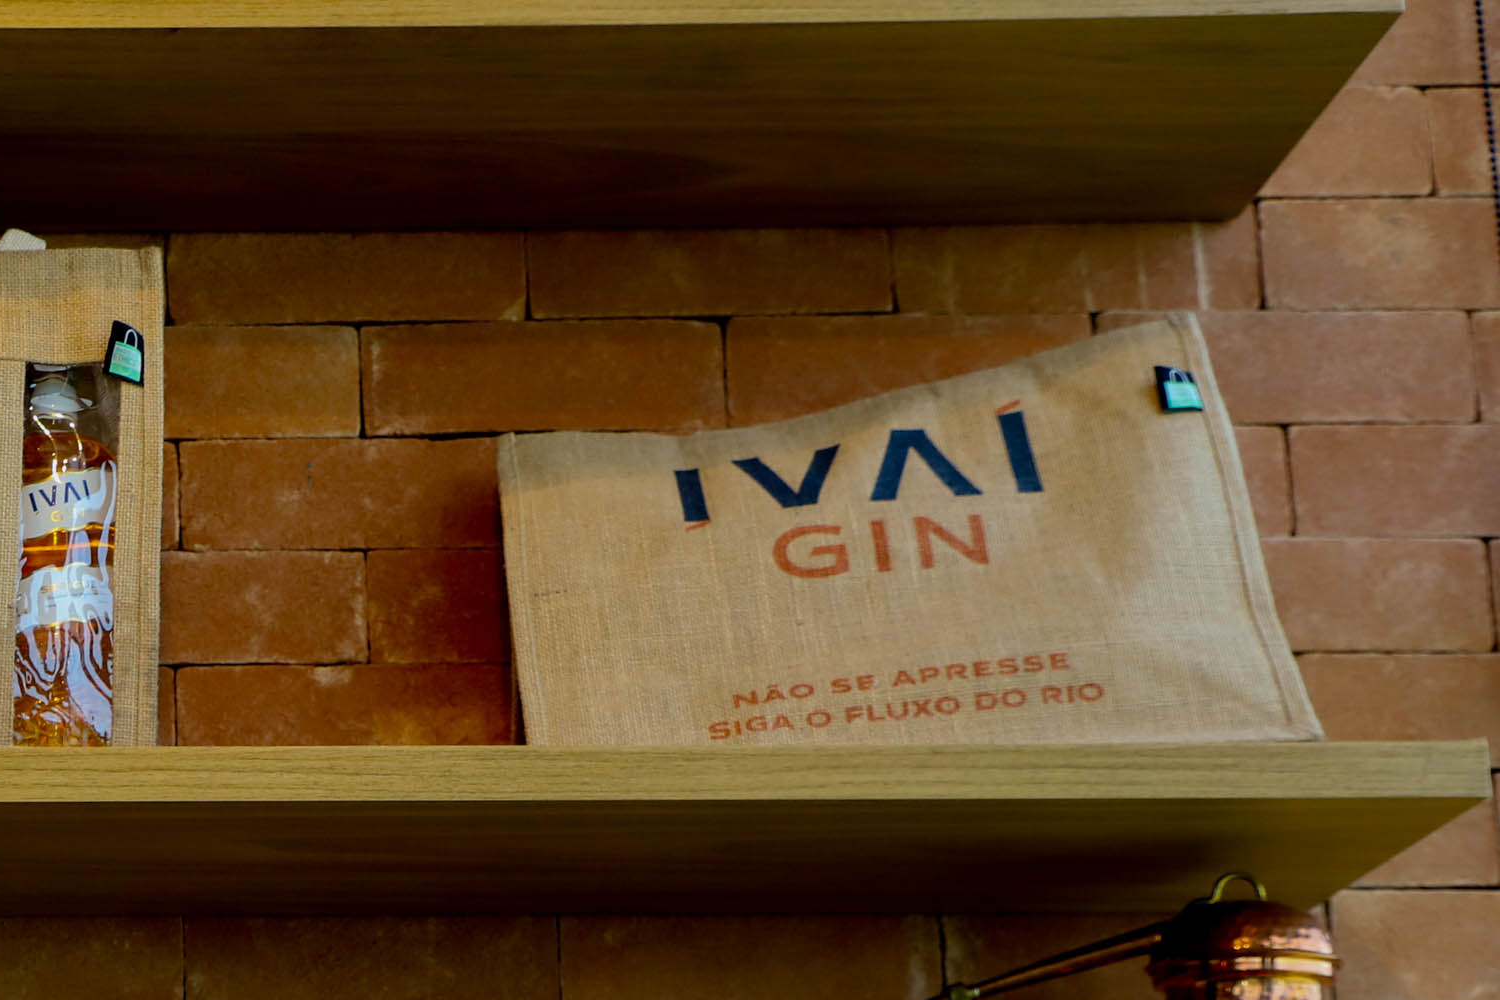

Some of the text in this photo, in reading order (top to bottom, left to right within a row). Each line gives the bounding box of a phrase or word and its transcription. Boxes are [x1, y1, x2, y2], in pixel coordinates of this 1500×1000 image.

[772, 514, 990, 579] GIN
[732, 652, 1071, 709] NÃO SE APRESSE
[708, 682, 1104, 740] SIGA O FLUXO DO RIO
